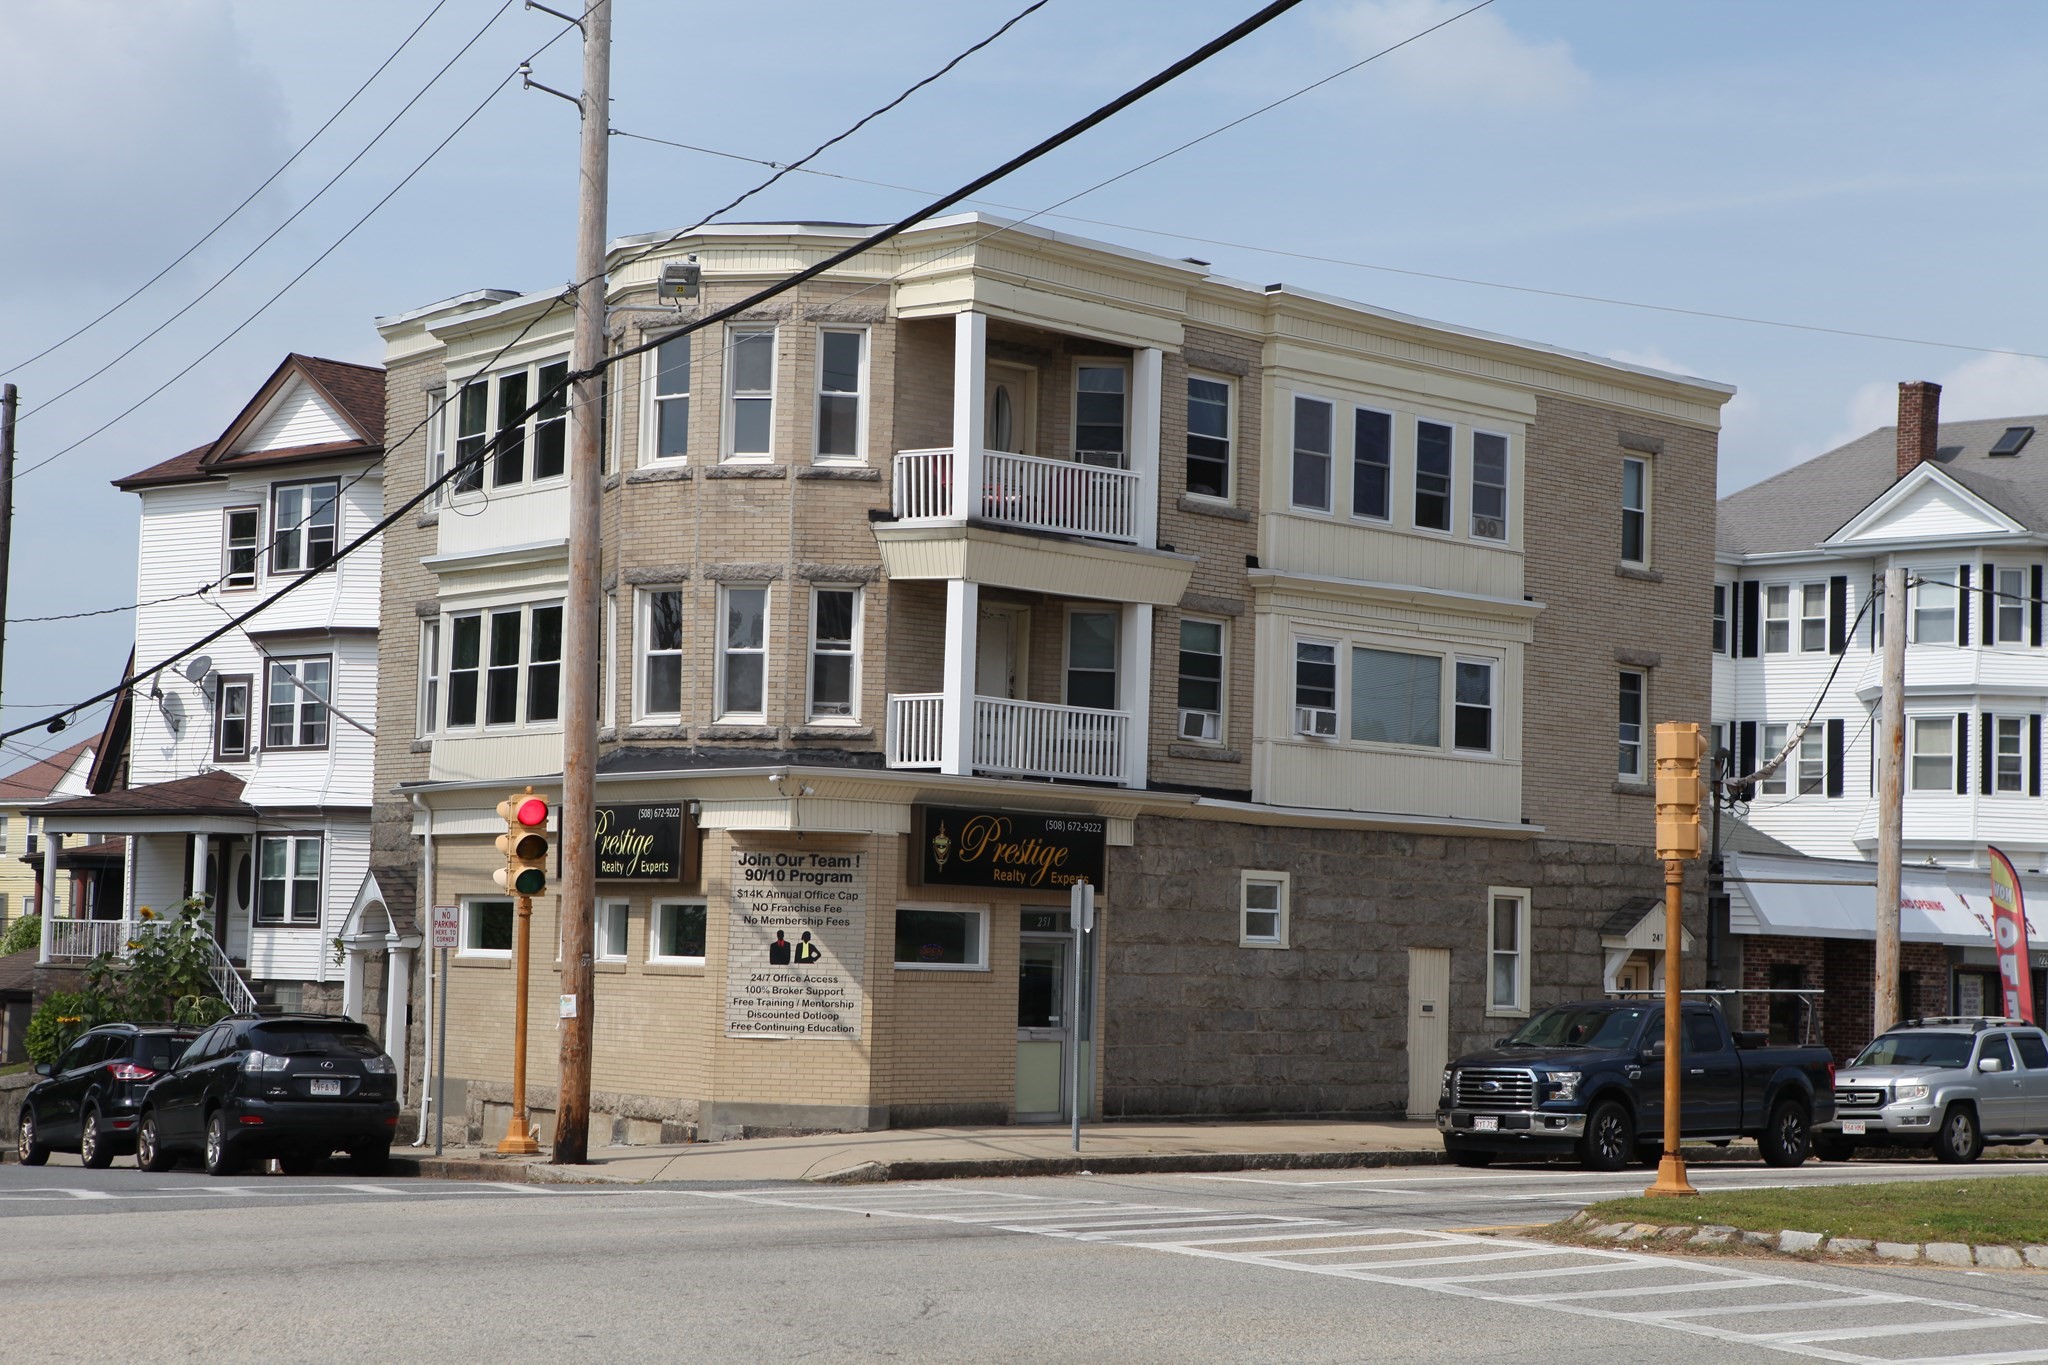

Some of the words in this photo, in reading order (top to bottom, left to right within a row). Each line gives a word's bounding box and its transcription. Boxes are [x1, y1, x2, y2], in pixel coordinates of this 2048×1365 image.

[638, 808, 654, 820] (508)
[654, 807, 680, 818] 672-9222
[1045, 820, 1066, 832] (508)
[1067, 821, 1102, 833] 672-9222
[595, 810, 654, 876] Prestige
[959, 815, 1069, 887] Prestige
[738, 852, 771, 867] Join
[776, 853, 806, 867] Our
[809, 854, 851, 868] Team
[601, 861, 624, 875] Realty
[641, 860, 669, 875] Experts
[745, 869, 786, 881] 90/10
[790, 870, 853, 885] Program
[994, 868, 1026, 884] Realty
[1051, 872, 1089, 885] Experts
[737, 889, 763, 899] $14K
[766, 889, 802, 899] Annual
[804, 890, 836, 900] Office
[838, 891, 859, 902] Cap
[752, 903, 769, 912] NO
[771, 903, 821, 913] Franchise
[824, 904, 842, 913] Fee
[1914, 899, 1945, 911] OPENING
[442, 911, 451, 920] NO
[743, 915, 758, 924] No
[760, 916, 824, 927] Membership
[826, 917, 850, 926] Fees
[1038, 916, 1051, 927] 251
[434, 920, 457, 929] PARKING
[1652, 933, 1664, 942] 247
[751, 974, 771, 983] 24/7
[773, 974, 802, 983] Office
[803, 975, 839, 984] Access
[745, 986, 770, 994] 100%
[772, 986, 803, 995] Broker
[806, 987, 844, 997] Support
[733, 998, 754, 1006] Free
[757, 998, 794, 1009] Training
[801, 999, 855, 1010] Mentorship
[747, 1010, 800, 1019] Discounted
[802, 1011, 840, 1022] Dotloop
[731, 1022, 752, 1031] Free
[754, 1022, 805, 1033] Continuing
[807, 1023, 855, 1033] Education
